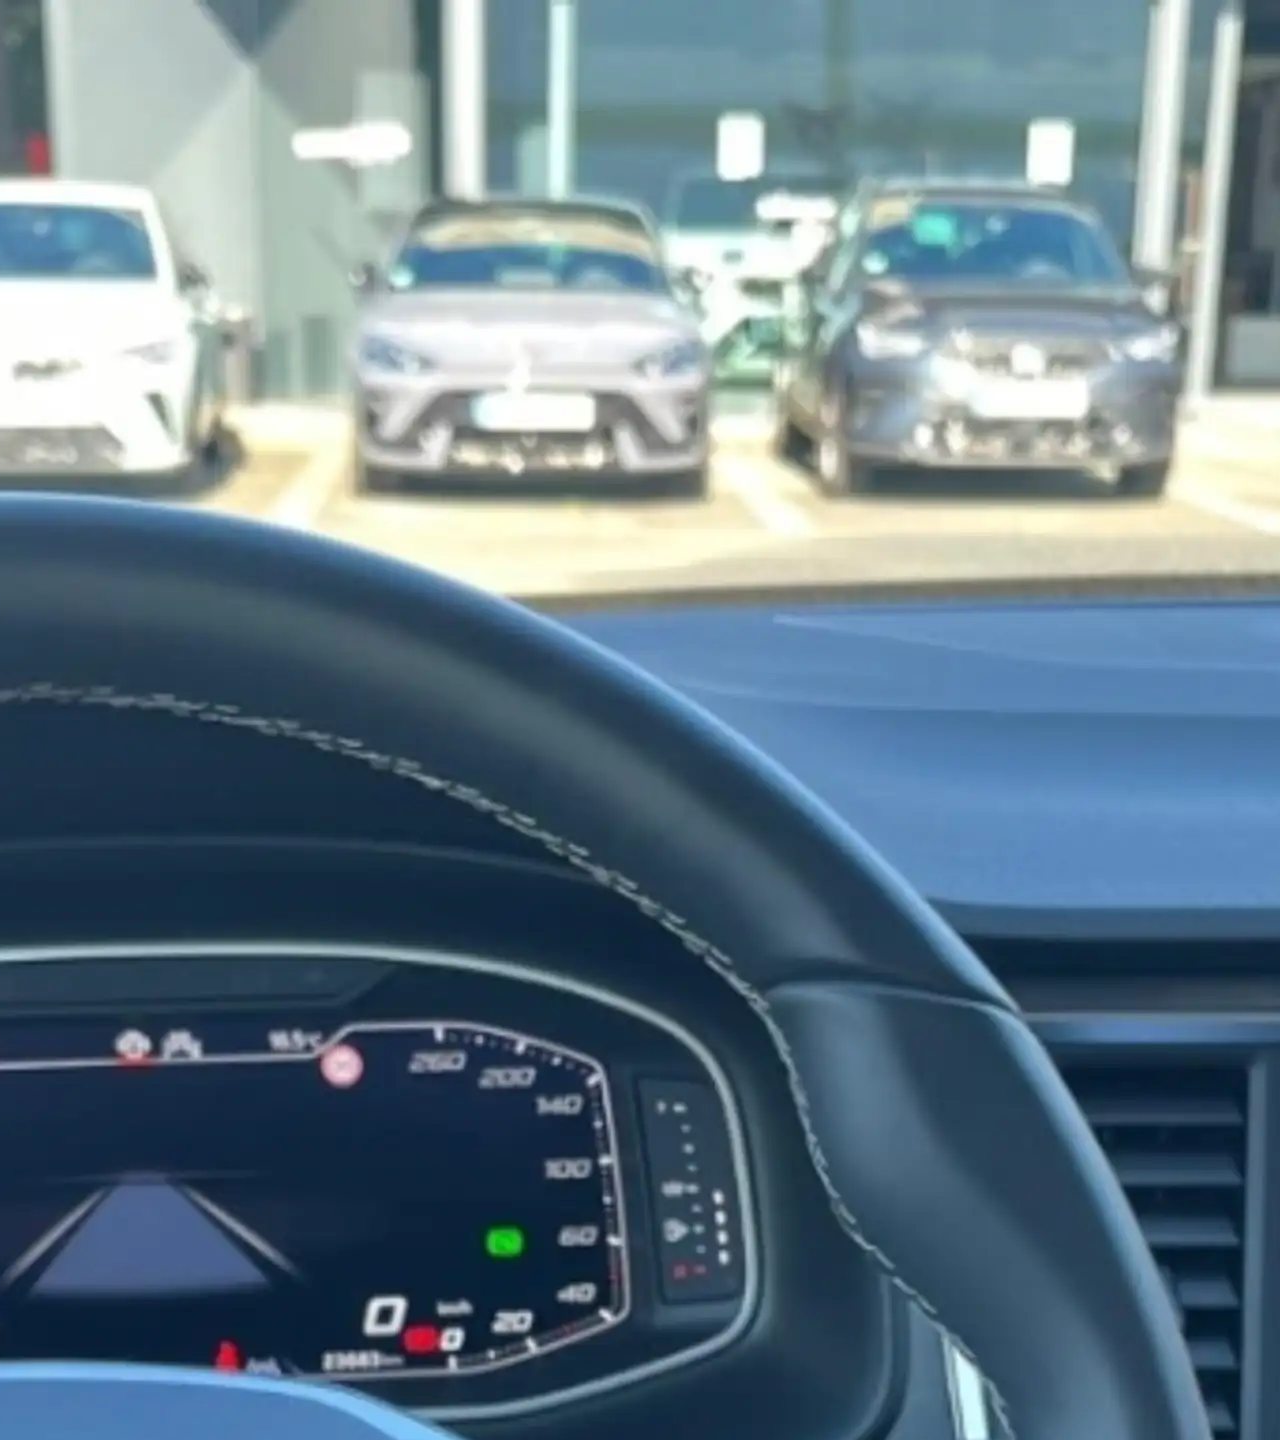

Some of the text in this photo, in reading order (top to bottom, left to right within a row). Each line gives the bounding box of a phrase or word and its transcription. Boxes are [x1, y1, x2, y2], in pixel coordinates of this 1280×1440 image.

[408, 1051, 467, 1073] 260
[478, 1067, 537, 1089] 200
[535, 1095, 584, 1116] 140
[544, 1157, 593, 1179] 100
[557, 1225, 599, 1247] 60
[556, 1282, 597, 1303] 40
[363, 1295, 409, 1337] 0
[491, 1310, 534, 1334] 20
